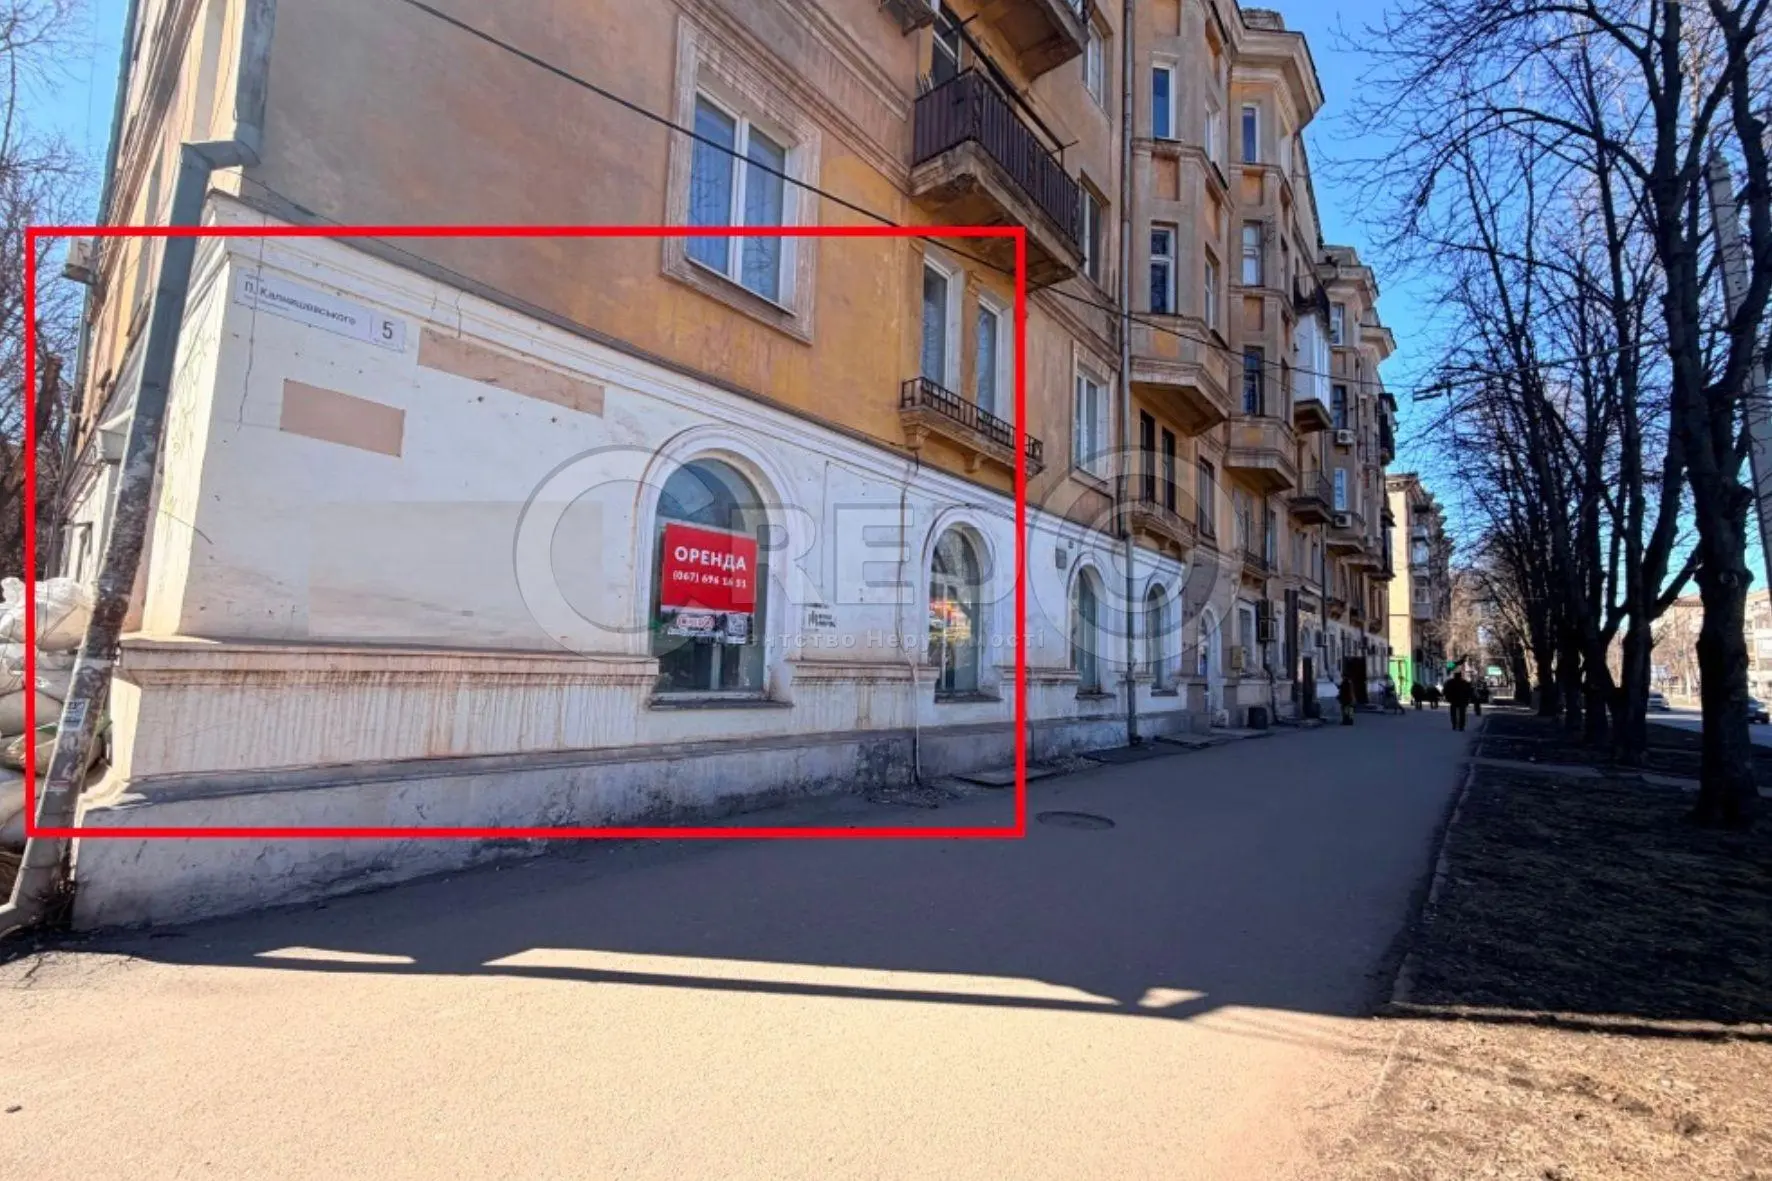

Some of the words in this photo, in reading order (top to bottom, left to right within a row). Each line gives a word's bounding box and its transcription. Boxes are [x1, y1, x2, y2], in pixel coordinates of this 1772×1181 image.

[381, 320, 394, 340] 5
[674, 545, 747, 573] ОРЕНДА
[672, 569, 700, 584] (067)
